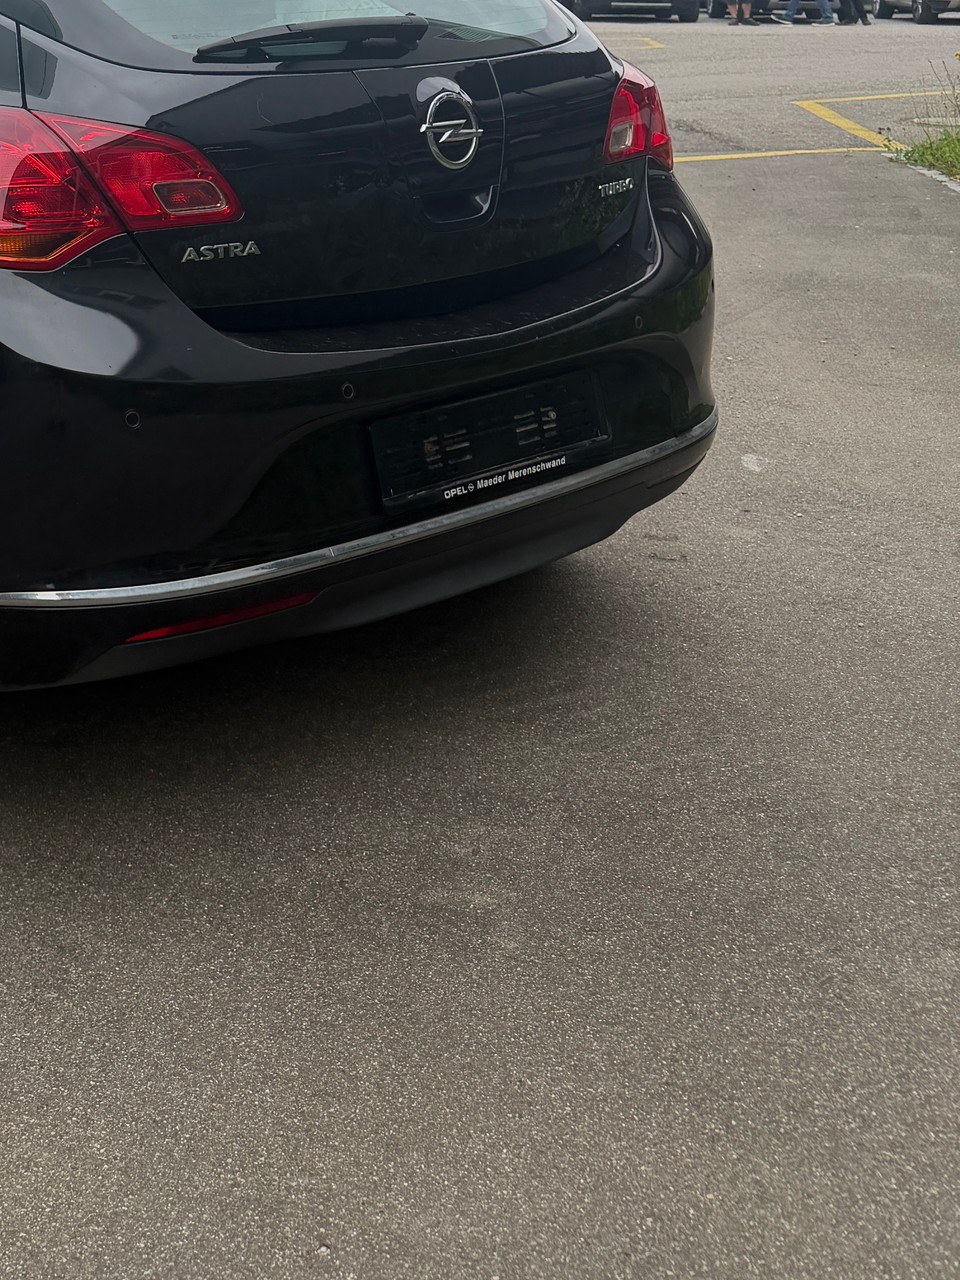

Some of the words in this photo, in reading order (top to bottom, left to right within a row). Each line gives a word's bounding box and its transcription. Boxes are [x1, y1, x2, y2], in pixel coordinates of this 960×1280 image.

[181, 240, 260, 263] ASTRA
[444, 486, 468, 499] OPEL
[477, 474, 506, 489] Maeder
[508, 456, 566, 480] Merenschwand
